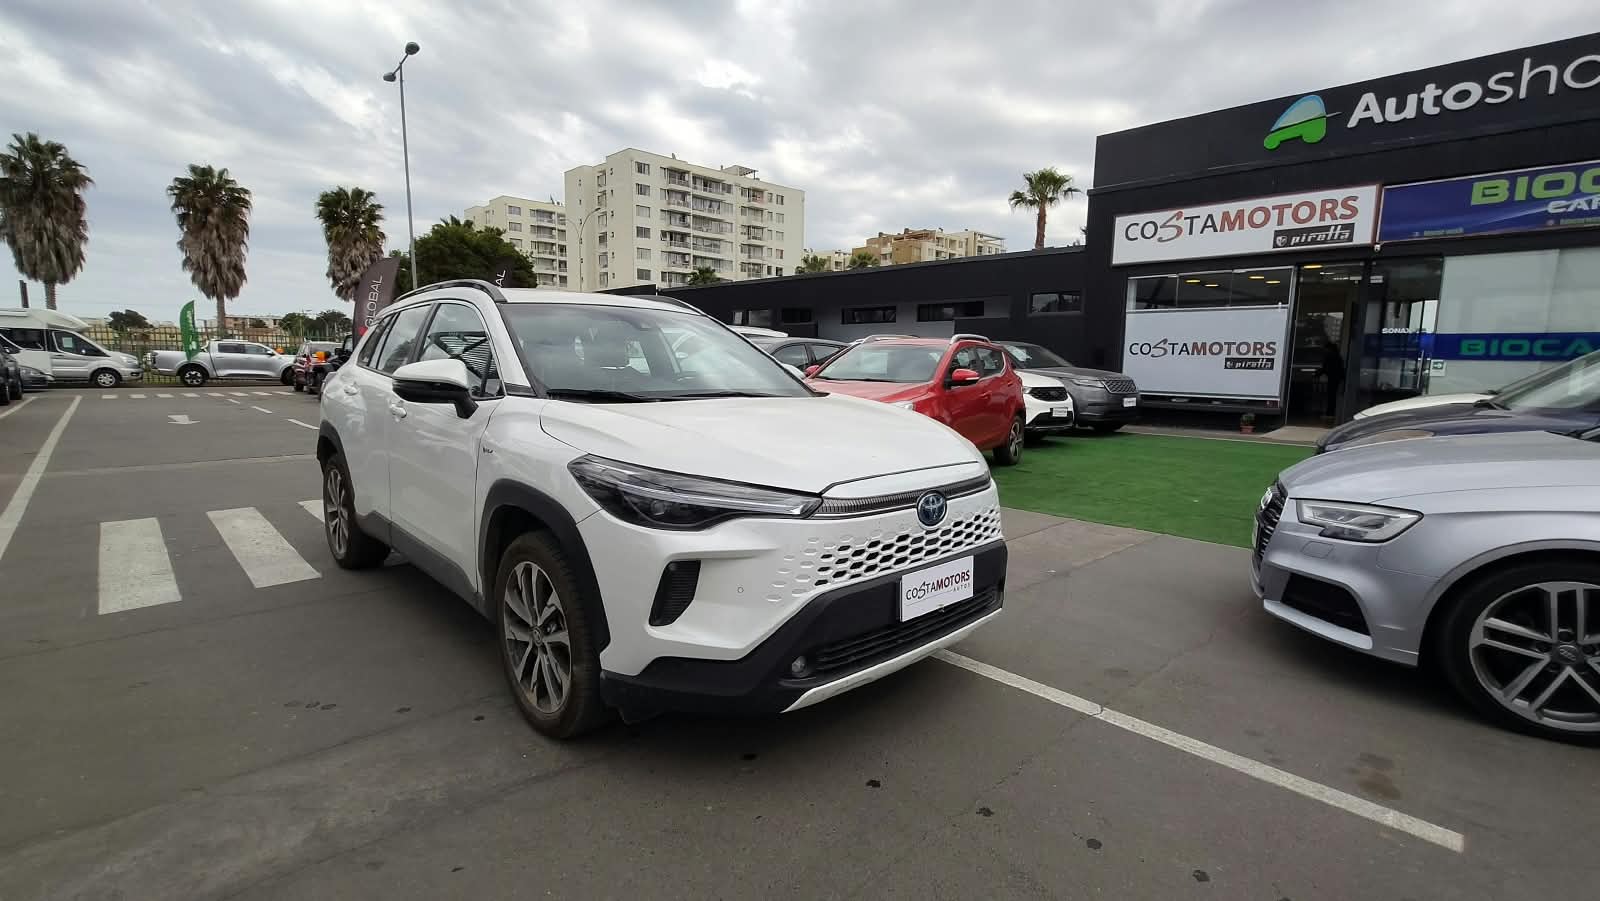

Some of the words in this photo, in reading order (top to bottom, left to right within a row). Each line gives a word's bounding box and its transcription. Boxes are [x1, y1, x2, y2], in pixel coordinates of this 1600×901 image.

[1124, 196, 1360, 242] COSTAMOTORS
[1290, 225, 1350, 245] piretta
[365, 275, 383, 328] GLOBAL
[1129, 338, 1277, 358] COSTAMOTORS
[905, 569, 971, 600] COSTAMOTORS
